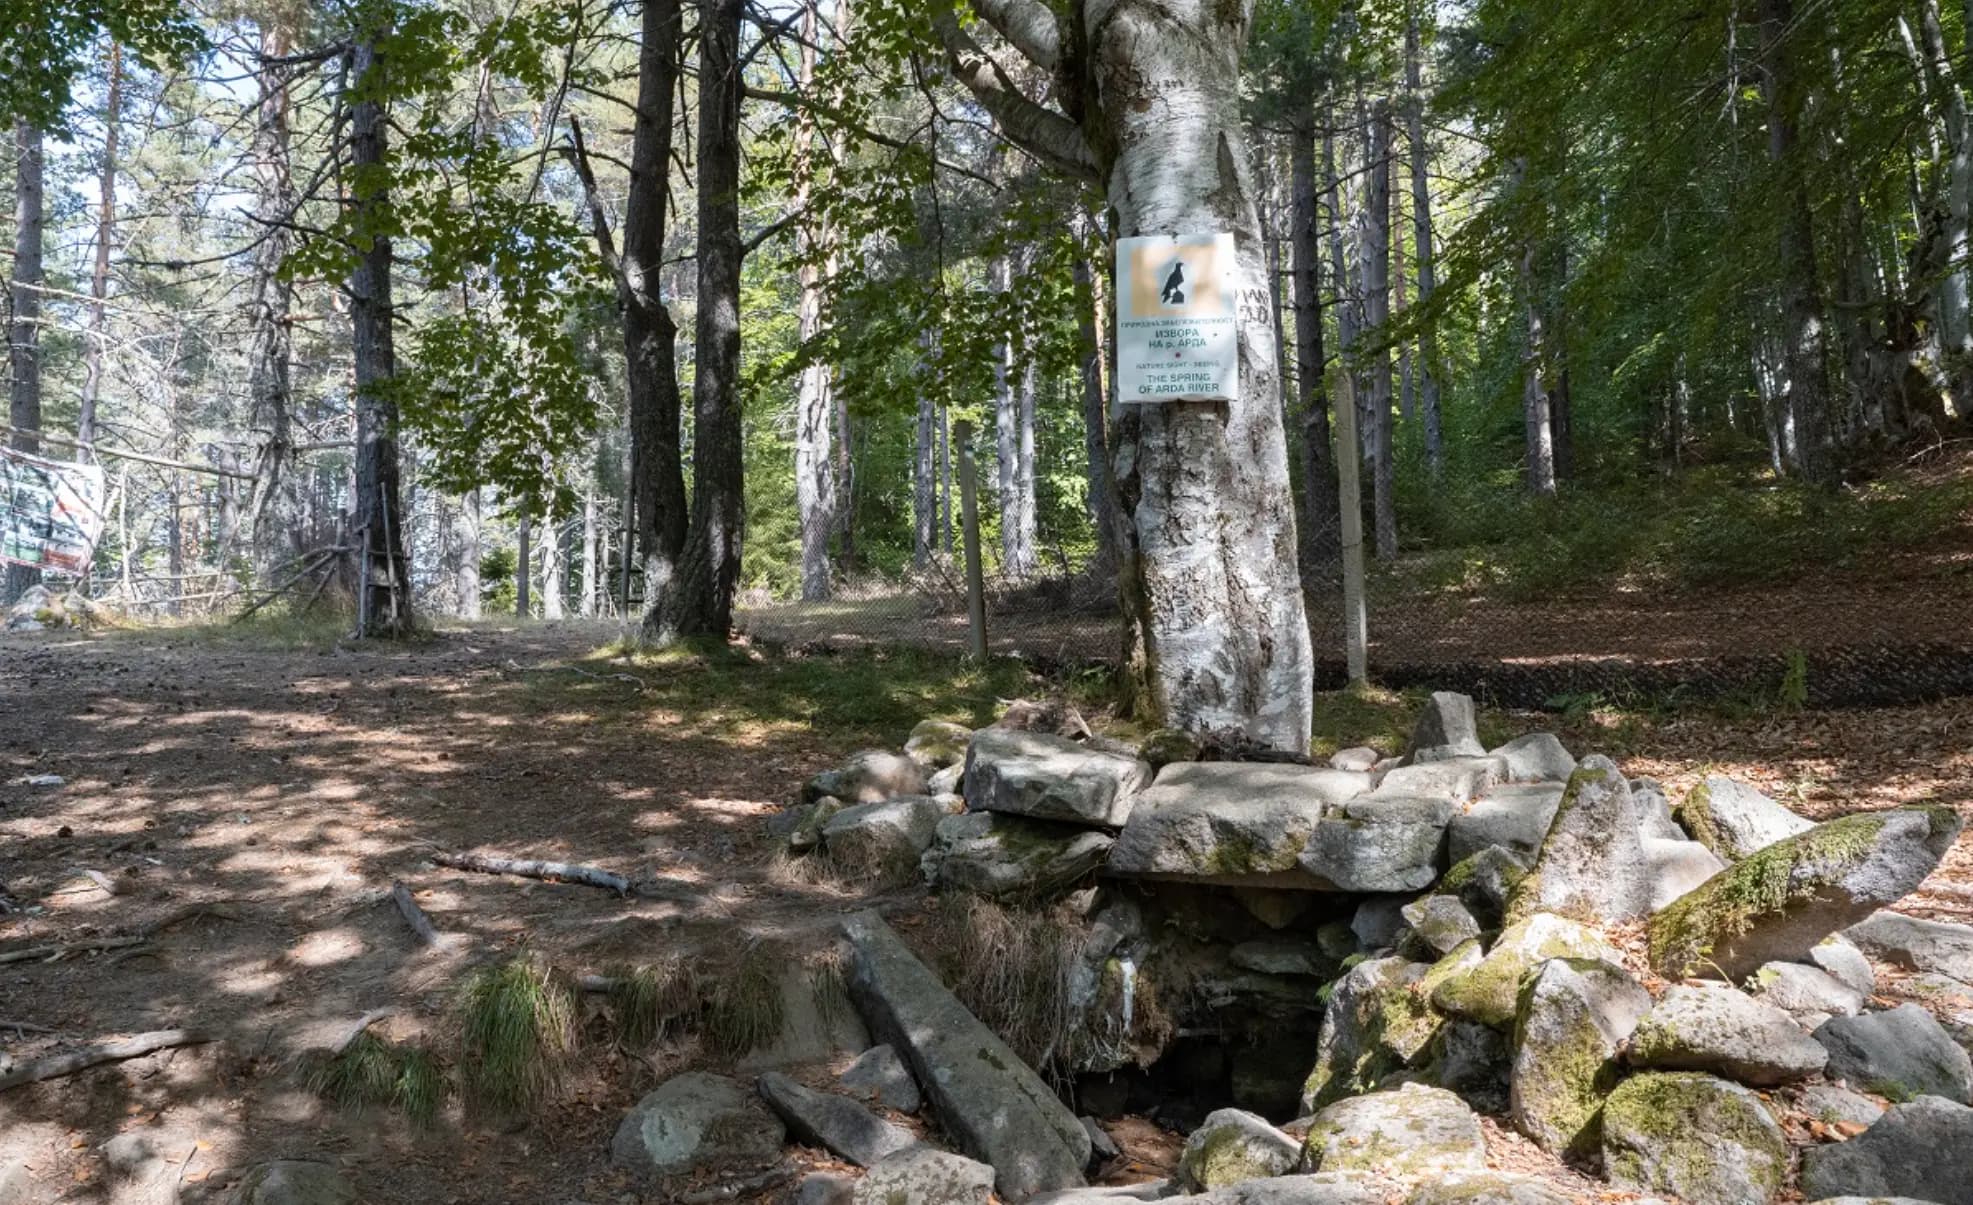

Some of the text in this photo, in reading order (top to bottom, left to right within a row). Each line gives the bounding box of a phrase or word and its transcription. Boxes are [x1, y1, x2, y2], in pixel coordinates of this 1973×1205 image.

[1155, 328, 1200, 338] ИЗВОРА
[1148, 339, 1163, 349] НА
[1146, 372, 1211, 383] THE SPRING
[1138, 383, 1220, 394] OF ARDA RIVER
